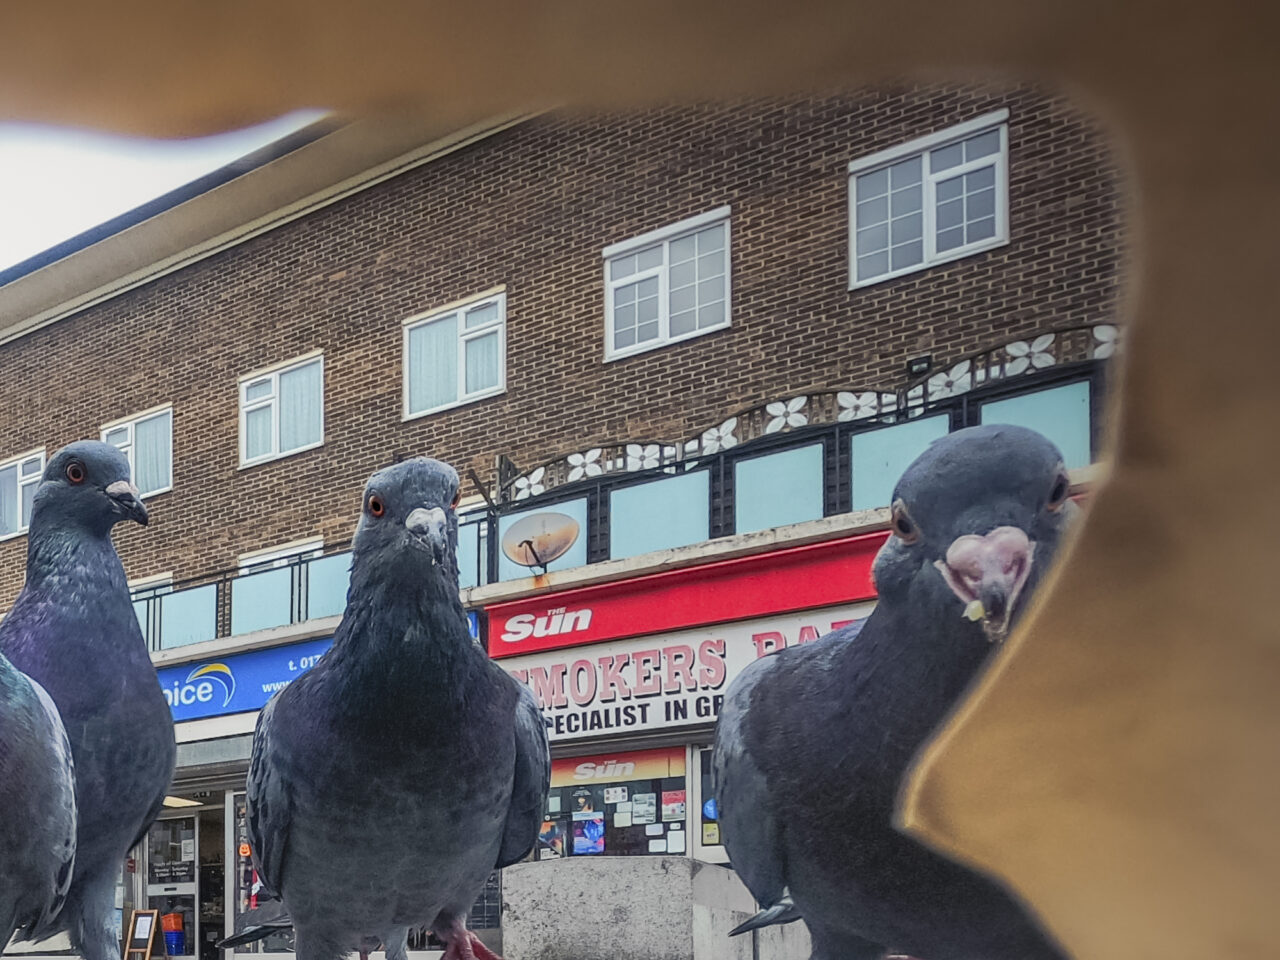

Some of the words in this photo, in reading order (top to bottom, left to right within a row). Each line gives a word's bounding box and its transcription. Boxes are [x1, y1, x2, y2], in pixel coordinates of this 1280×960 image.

[500, 608, 593, 643] Sun
[665, 699, 688, 721] IN
[573, 761, 635, 779] Sun
